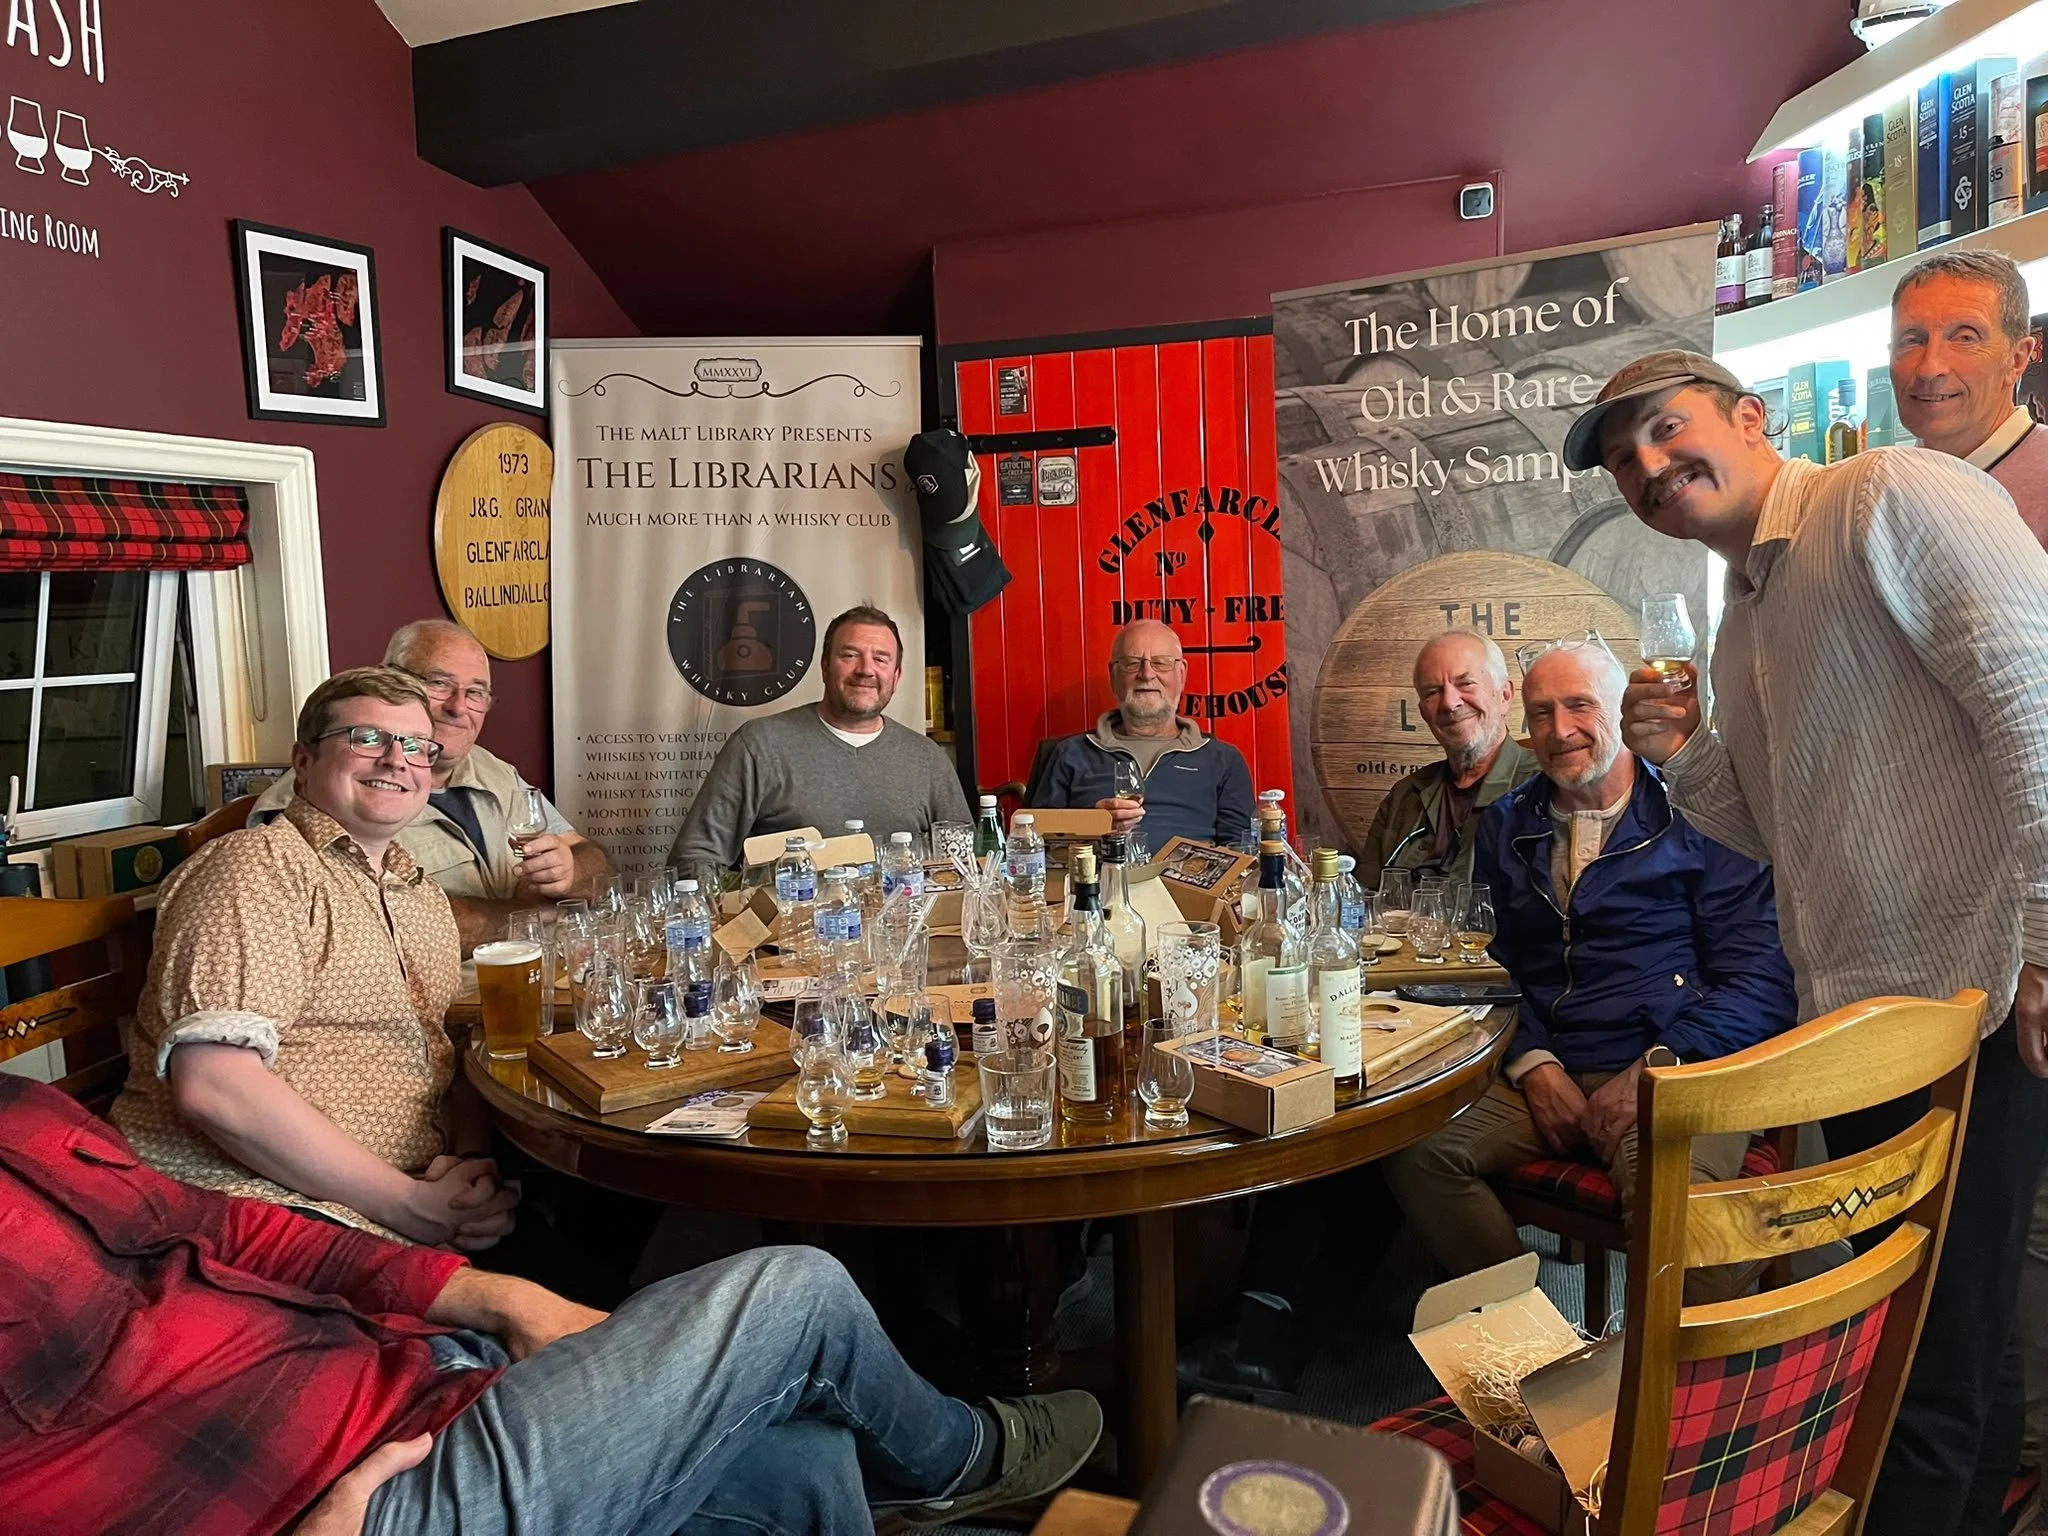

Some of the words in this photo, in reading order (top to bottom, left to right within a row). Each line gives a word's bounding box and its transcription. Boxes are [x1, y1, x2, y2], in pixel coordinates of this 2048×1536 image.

[1954, 83, 1972, 100] GLEN
[1920, 100, 1934, 112] GLEN
[1951, 94, 1976, 114] SCOTIA
[1919, 108, 1936, 123] SCOTIA
[1888, 117, 1904, 131] GLEN
[1886, 127, 1908, 144] SCOTIA
[1958, 125, 1968, 140] 15
[45, 213, 99, 259] ROOM
[1345, 311, 1418, 356] The
[1429, 301, 1561, 347] Home
[1572, 276, 1630, 329] of
[702, 367, 752, 378] MMXXVI
[1792, 380, 1809, 392] GLEN
[1361, 375, 1431, 424] Old
[1441, 376, 1481, 416] &
[1492, 371, 1594, 411] Rare
[1792, 389, 1812, 402] SCOTIA
[596, 425, 634, 442] THE
[640, 427, 691, 442] MALT
[697, 425, 775, 442] LIBRARY
[782, 426, 872, 442] PRESENTS
[498, 452, 529, 475] 1973
[1314, 446, 1455, 497] Whisky
[1465, 445, 1601, 493] Samp
[577, 457, 655, 489] THE
[668, 457, 897, 490] LIBRARIANS
[586, 512, 641, 526] MUCH
[647, 512, 698, 526] MORE
[703, 512, 752, 526] THAN
[757, 513, 770, 526] A
[774, 513, 841, 527] WHISKY
[846, 513, 891, 528] CLUB
[673, 589, 695, 623] THE
[704, 564, 810, 624] LIBRARIANS
[1112, 598, 1197, 626] DUTY
[1440, 602, 1522, 636] THE
[682, 659, 748, 700] WHISKY
[764, 659, 804, 696] CLUB
[1177, 661, 1287, 718] EHOUS
[586, 734, 634, 744] ACCESS
[639, 734, 655, 744] TO
[657, 733, 691, 743] VERY
[586, 752, 645, 762] WHISKIES
[648, 752, 676, 762] YOU
[586, 771, 641, 782] ANNUAL
[586, 789, 636, 800] WHISKY
[640, 788, 694, 798] TASTING
[586, 808, 651, 819] MONTHLY
[655, 807, 688, 818] CLUB
[587, 826, 632, 837] DRAMS
[635, 826, 646, 836] &
[648, 826, 676, 836] SETS
[610, 844, 669, 855] ITATIONS
